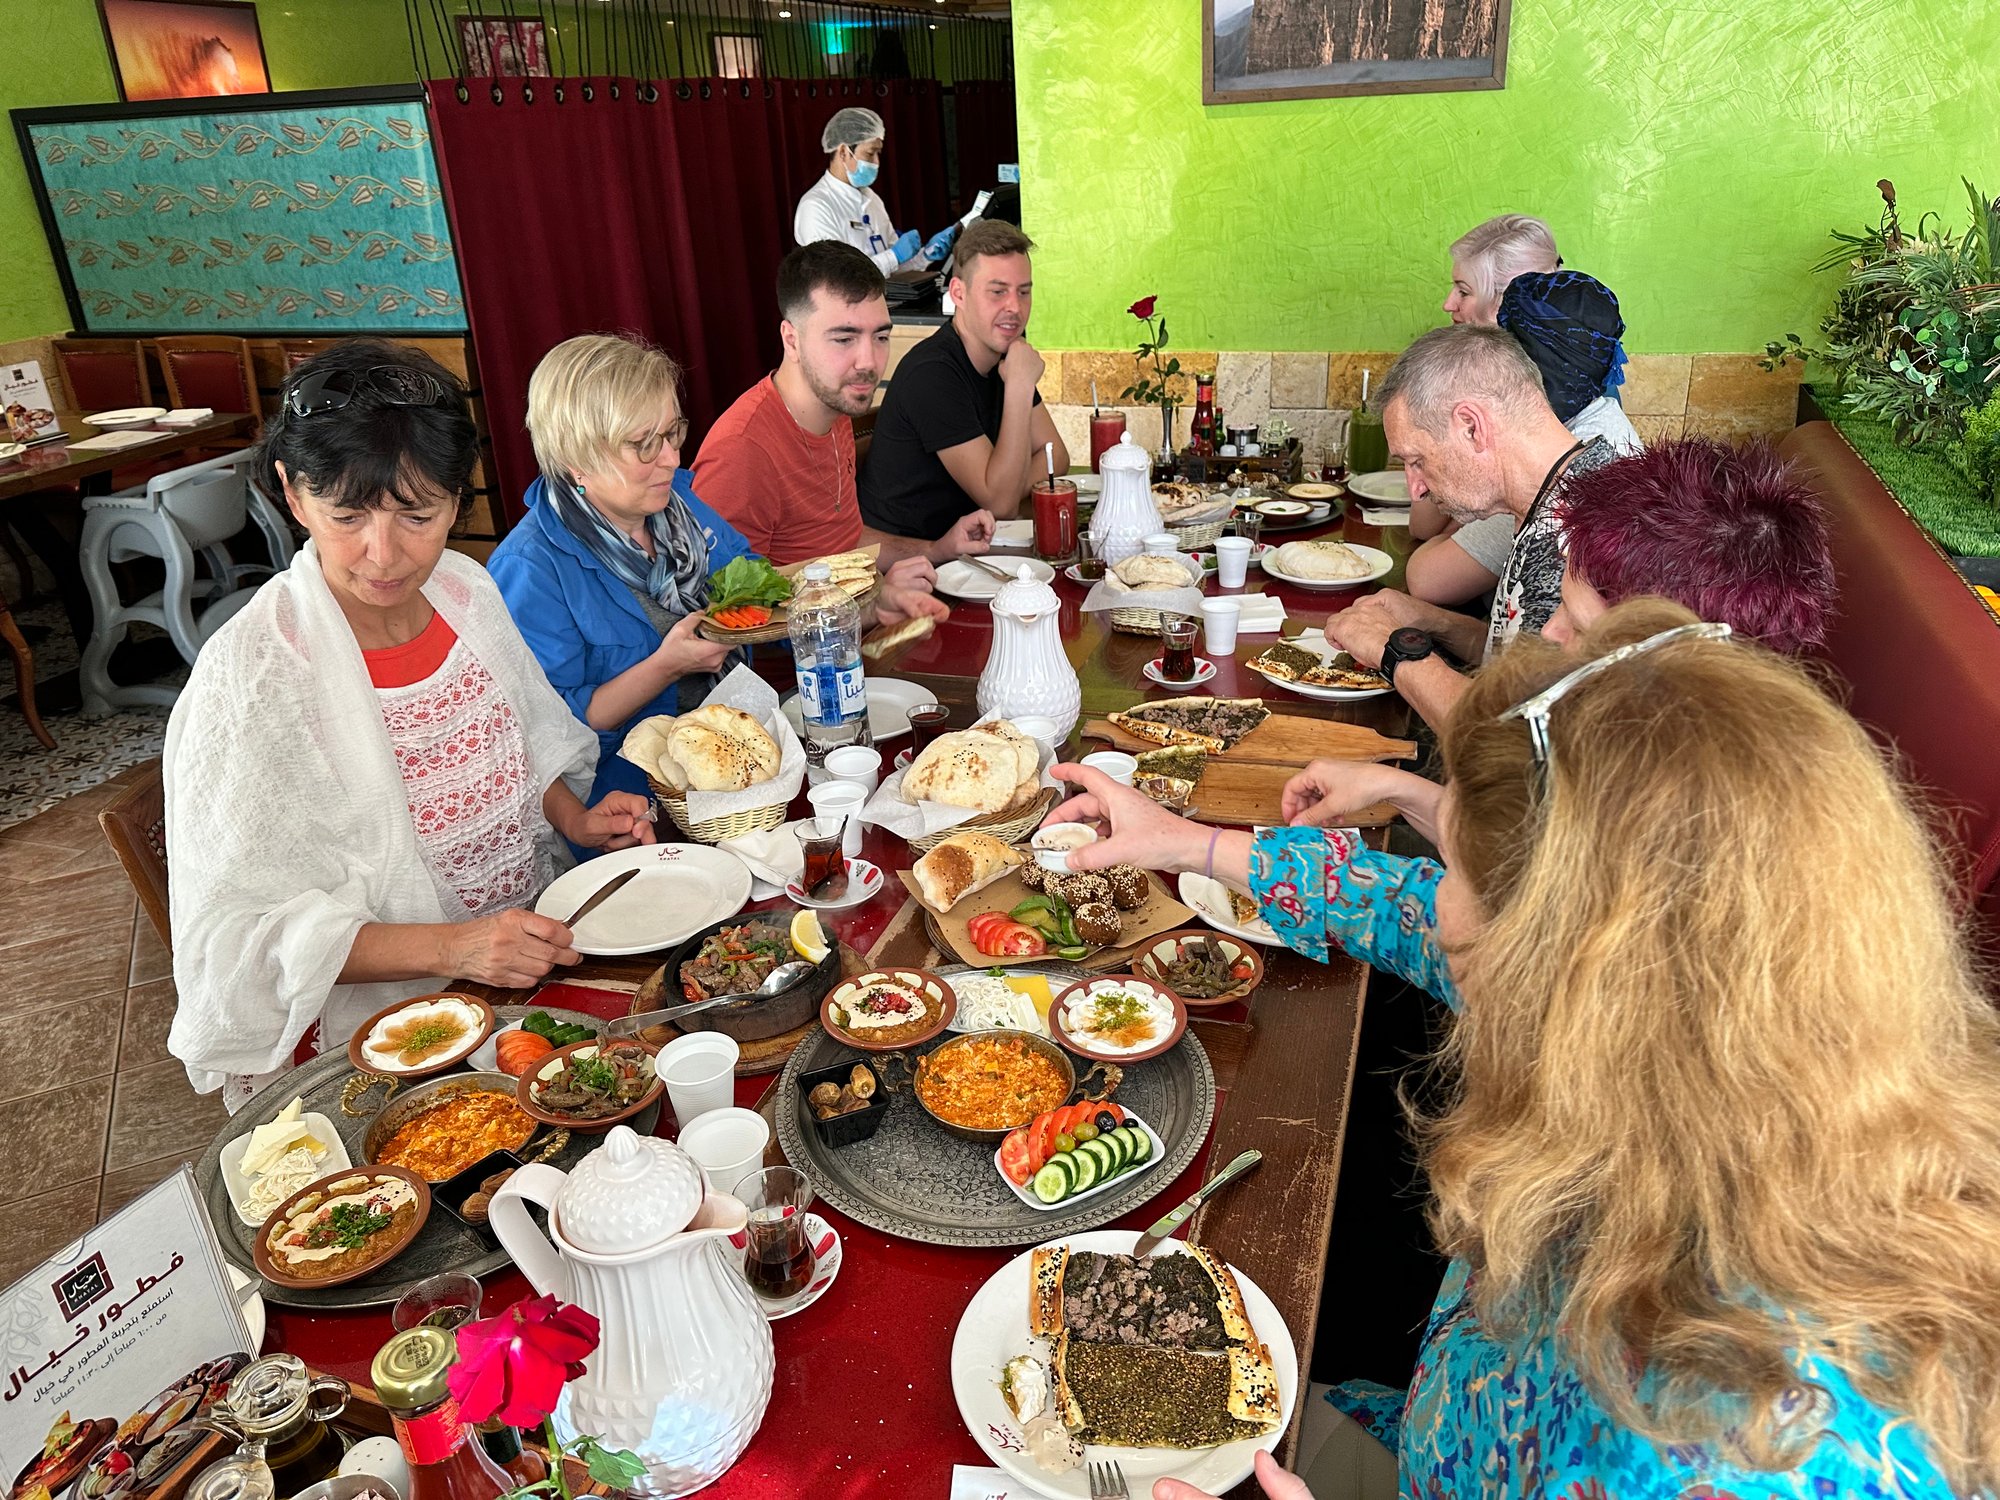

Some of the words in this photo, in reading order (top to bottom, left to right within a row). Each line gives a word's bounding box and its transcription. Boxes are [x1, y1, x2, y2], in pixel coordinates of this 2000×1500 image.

[98, 1251, 184, 1332] فطور
[141, 1287, 174, 1320] استمتع
[111, 1315, 139, 1340] بتجربة
[156, 1313, 168, 1326] من
[4, 1323, 90, 1402] خيال
[77, 1337, 109, 1370] الفطور
[100, 1352, 115, 1370] إلى
[58, 1366, 75, 1384] في
[33, 1381, 55, 1403] خيال
